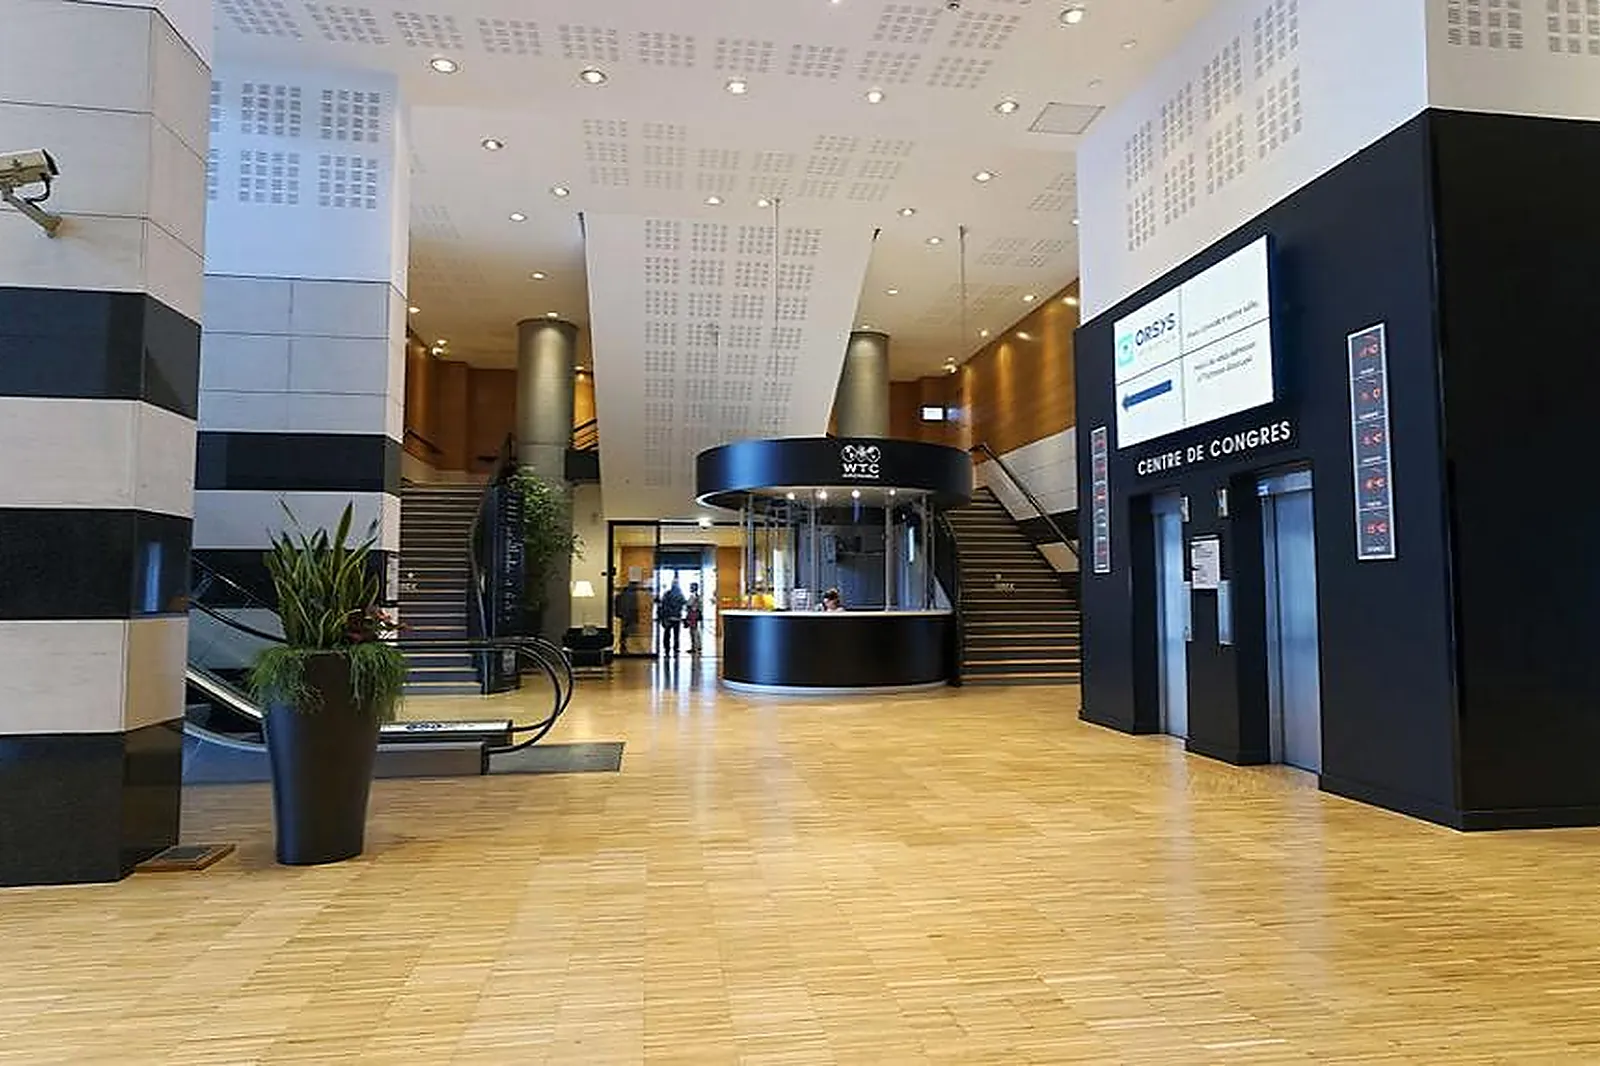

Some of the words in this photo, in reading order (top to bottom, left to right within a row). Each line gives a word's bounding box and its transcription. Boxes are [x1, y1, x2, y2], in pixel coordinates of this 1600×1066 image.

[1135, 312, 1176, 347] ORSYS
[1137, 450, 1182, 476] CENTRE
[1187, 444, 1205, 463] DE
[1210, 420, 1291, 457] CONGRES
[842, 463, 880, 474] WTC
